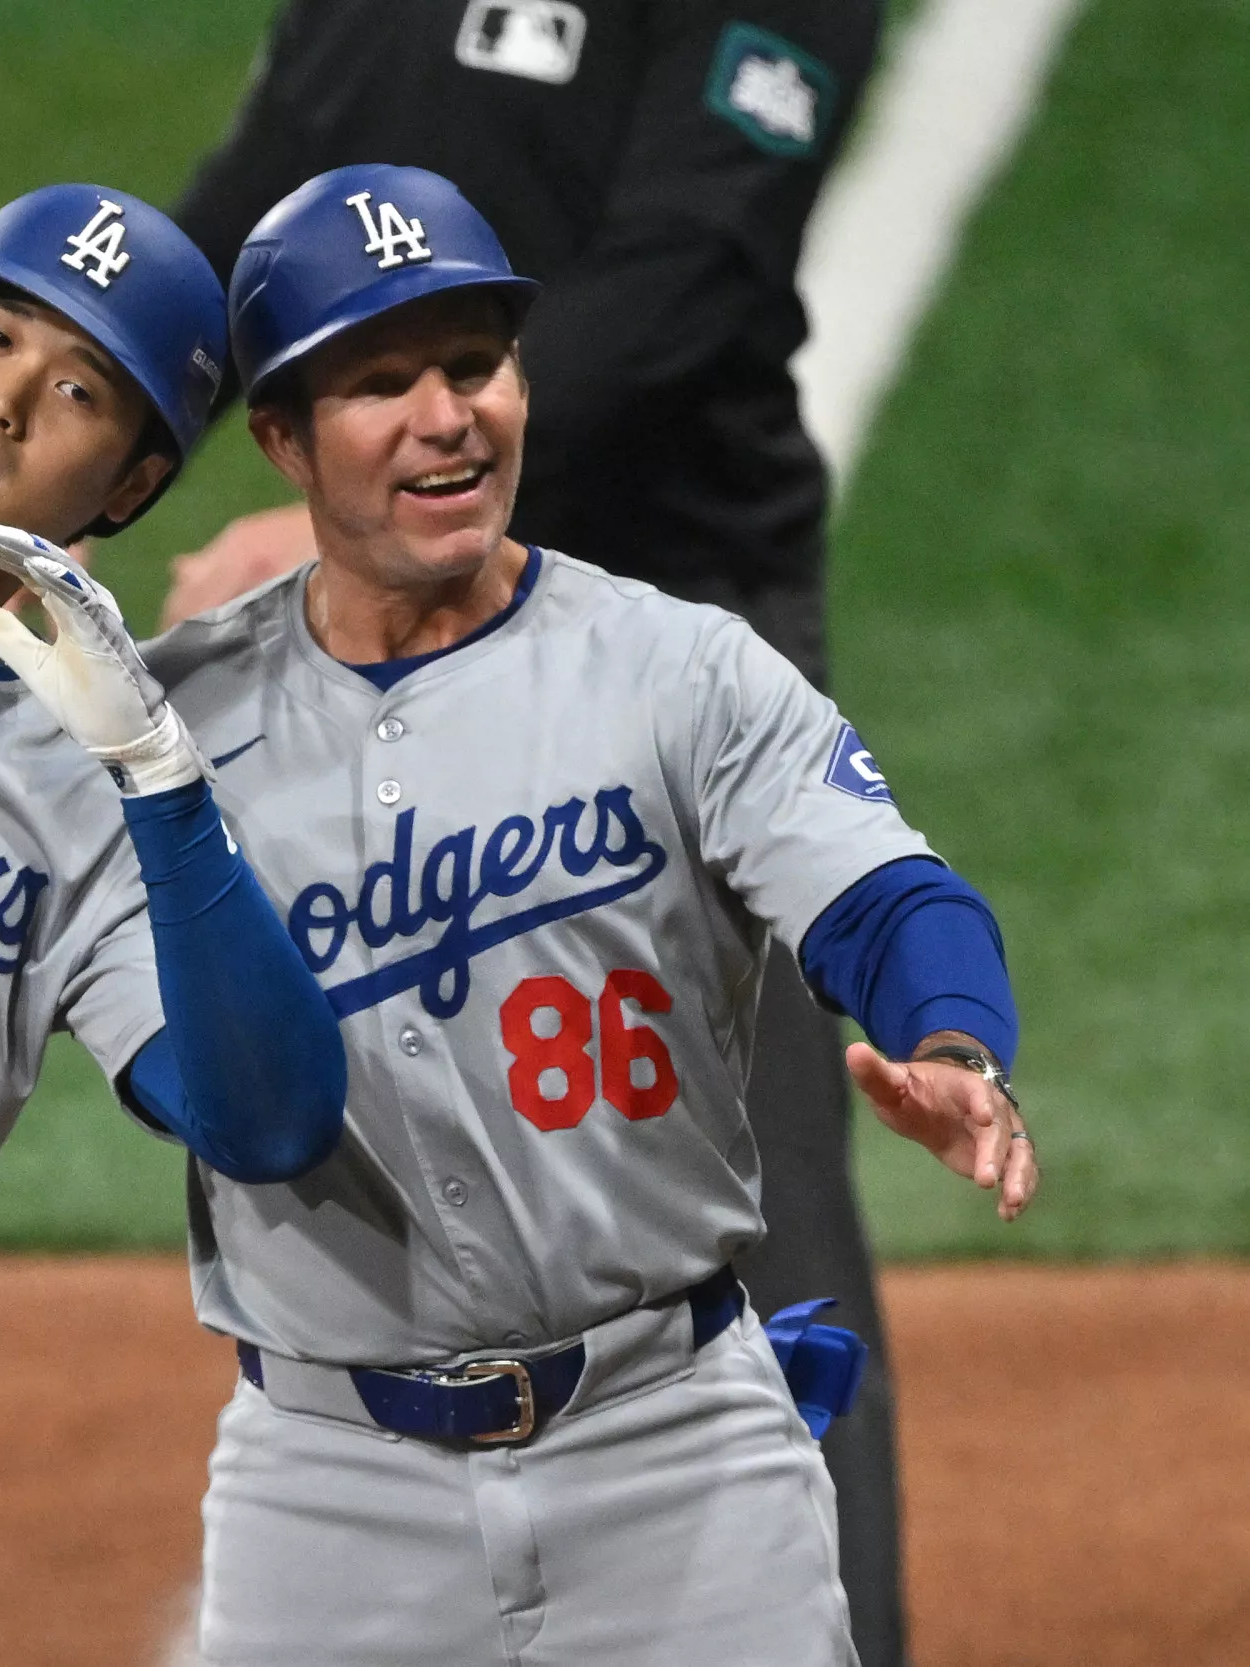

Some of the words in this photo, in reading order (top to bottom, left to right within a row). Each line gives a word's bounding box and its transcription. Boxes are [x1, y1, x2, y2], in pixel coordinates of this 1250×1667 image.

[60, 199, 130, 288] LA
[346, 192, 432, 269] LA
[289, 784, 667, 1019] odgers
[499, 969, 678, 1132] 86
